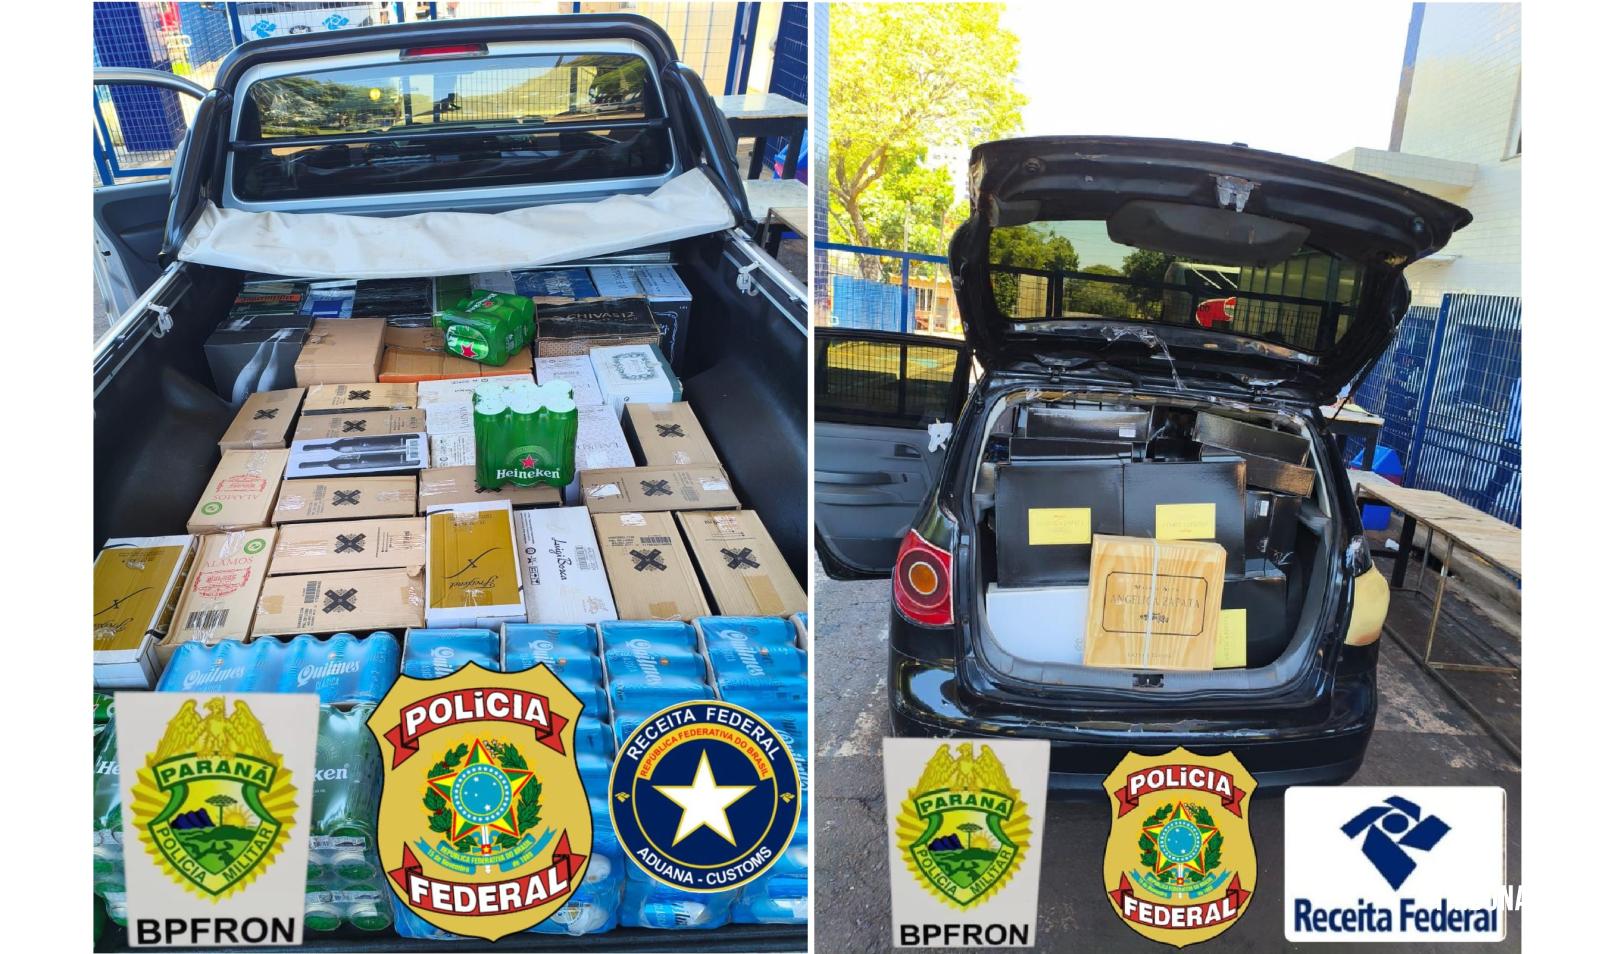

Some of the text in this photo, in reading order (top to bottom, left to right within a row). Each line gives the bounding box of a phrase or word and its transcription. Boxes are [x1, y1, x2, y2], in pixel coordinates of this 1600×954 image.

[496, 468, 560, 480] Heineken
[205, 557, 253, 568] ALAMOS
[549, 536, 573, 581] Luigi Bosca
[183, 667, 245, 690] Quilmes
[297, 660, 360, 687] Quilmes
